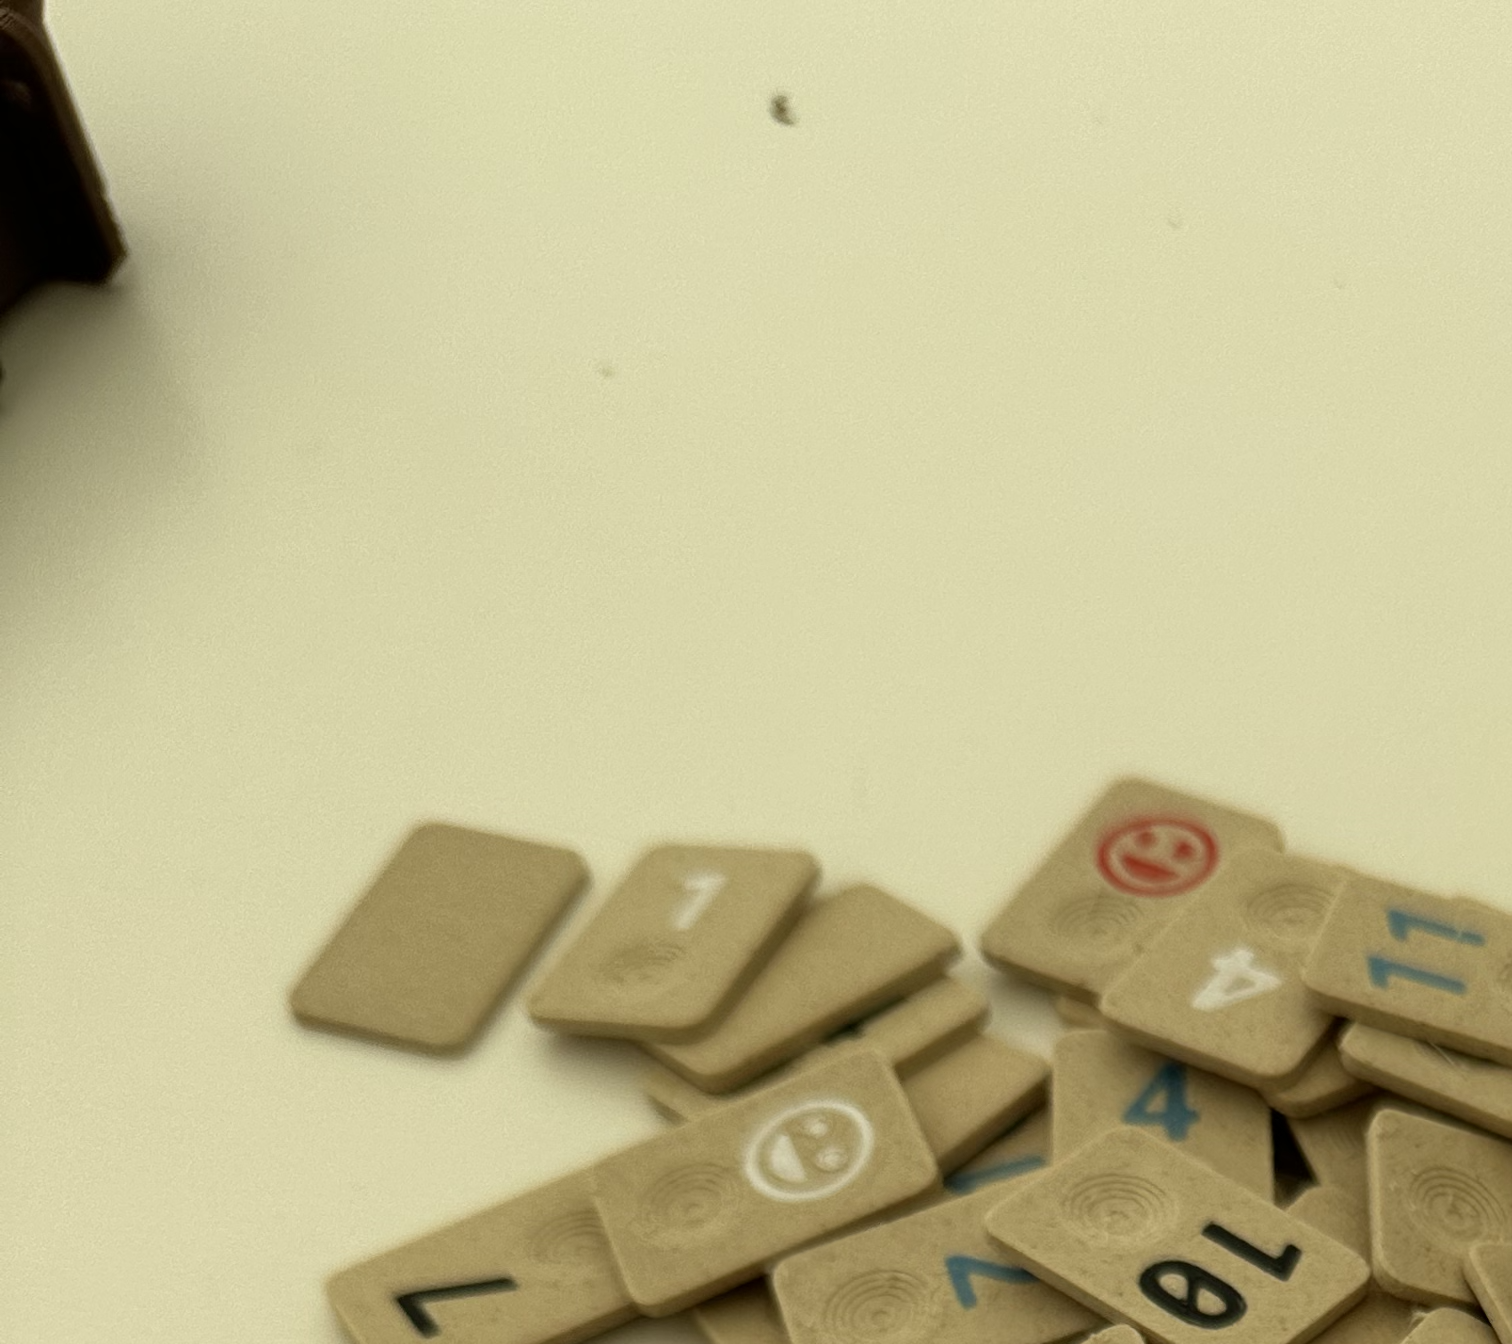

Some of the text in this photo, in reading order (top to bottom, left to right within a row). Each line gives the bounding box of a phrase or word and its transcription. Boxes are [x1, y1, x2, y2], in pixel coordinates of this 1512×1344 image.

[1366, 906, 1487, 995] 11
[1121, 1063, 1199, 1143] 4
[1138, 1220, 1302, 1332] 10
